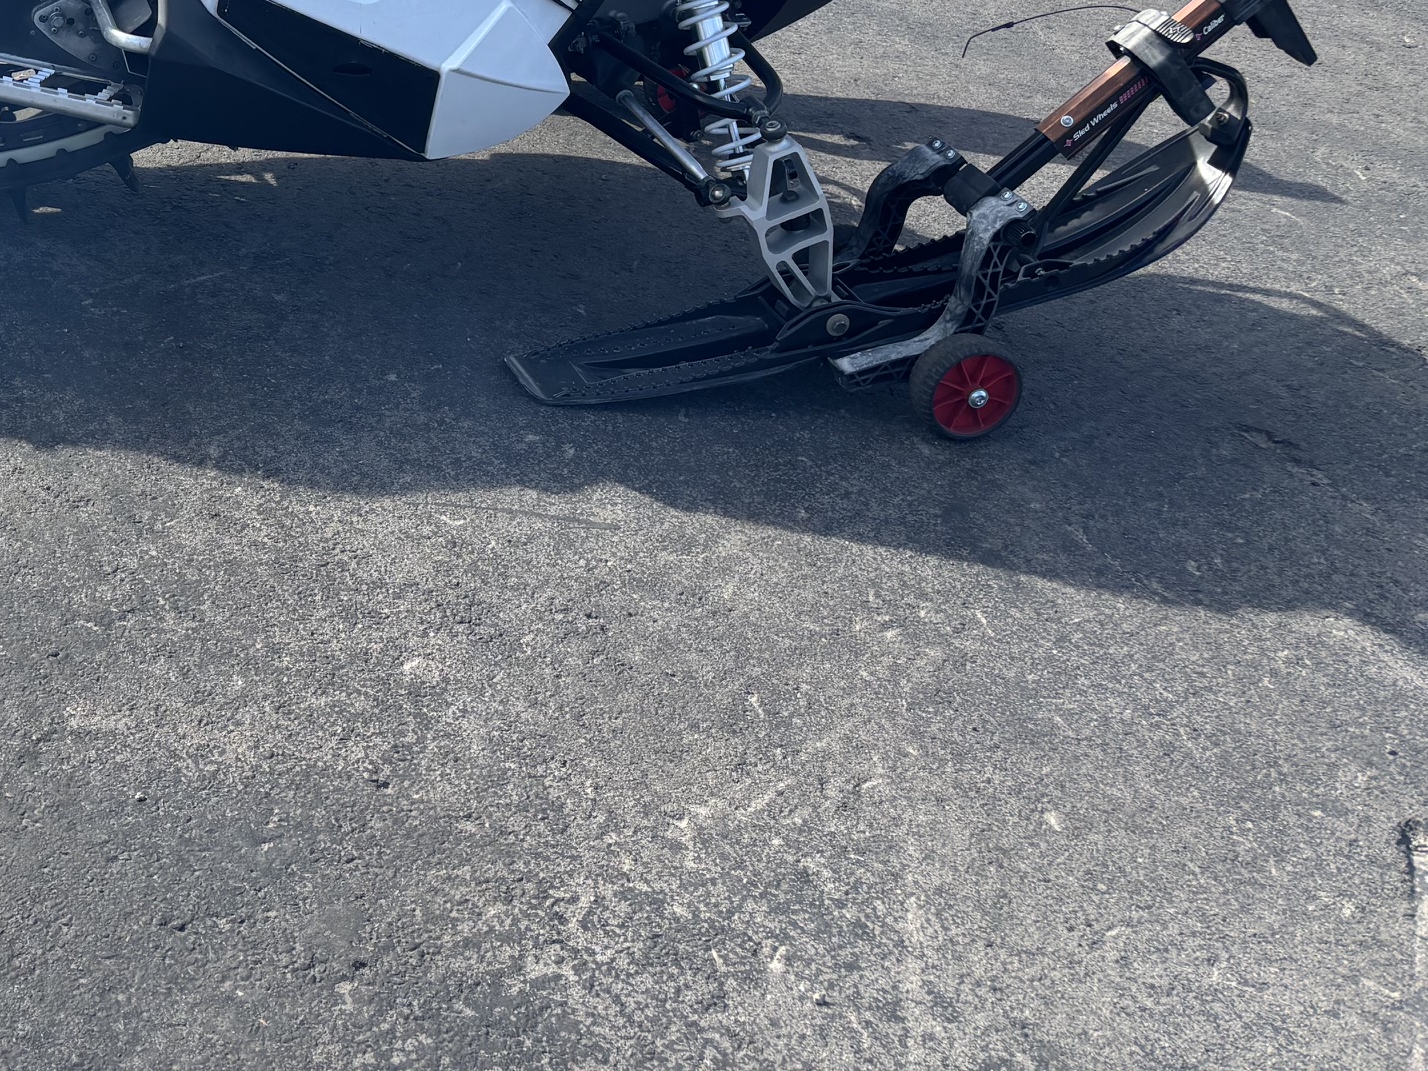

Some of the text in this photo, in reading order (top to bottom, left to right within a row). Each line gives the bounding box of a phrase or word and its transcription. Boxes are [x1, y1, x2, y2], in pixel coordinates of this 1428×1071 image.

[1202, 13, 1225, 36] Caliber
[1072, 100, 1119, 142] Sled Wheels
